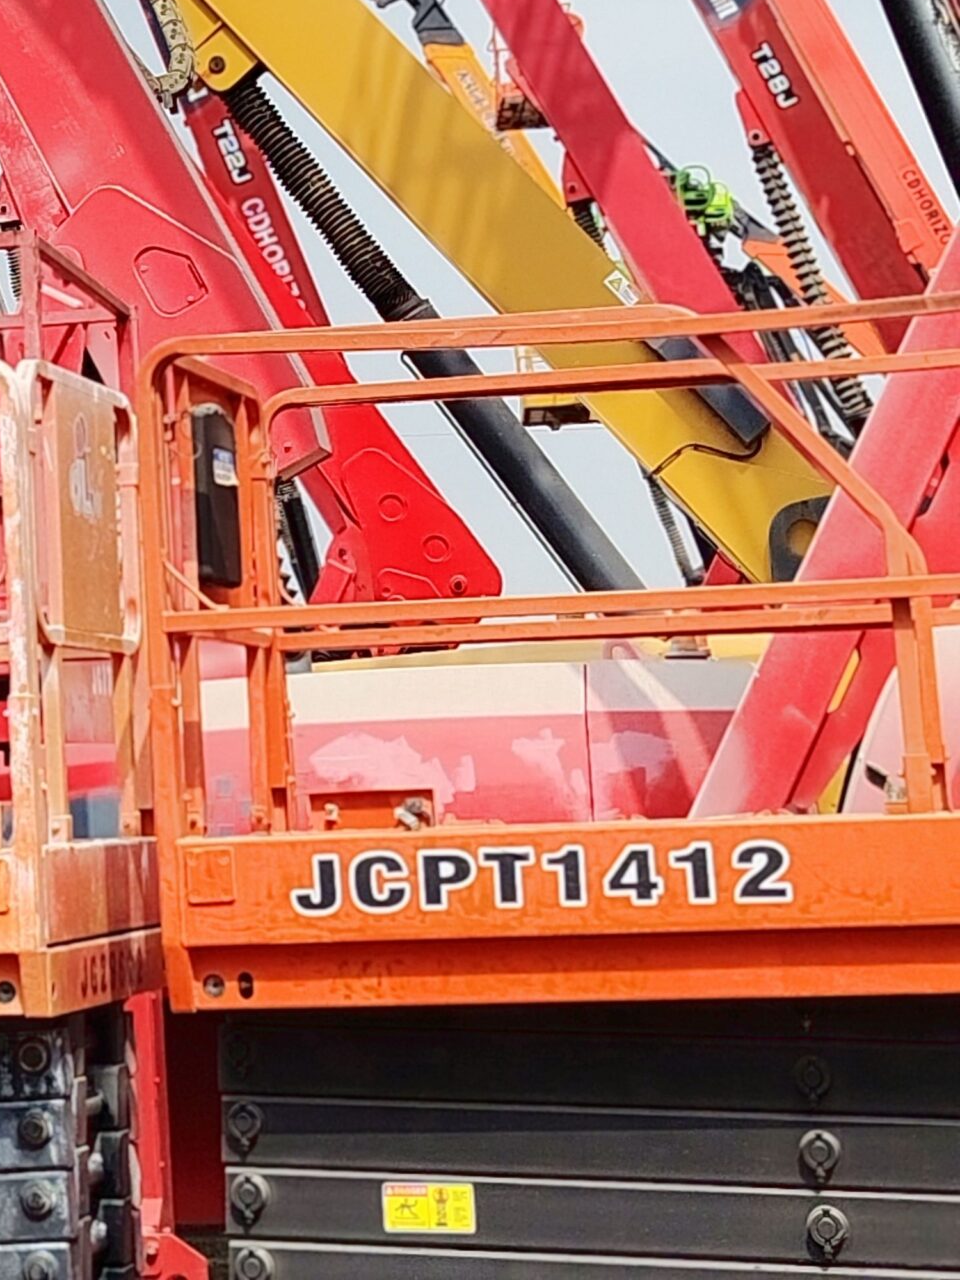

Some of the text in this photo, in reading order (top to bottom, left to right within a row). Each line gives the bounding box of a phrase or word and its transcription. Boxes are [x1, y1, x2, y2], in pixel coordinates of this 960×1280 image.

[752, 42, 799, 108] T28J
[213, 120, 253, 184] T22J
[241, 196, 307, 310] CDHOR
[292, 841, 792, 914] JCPT1412
